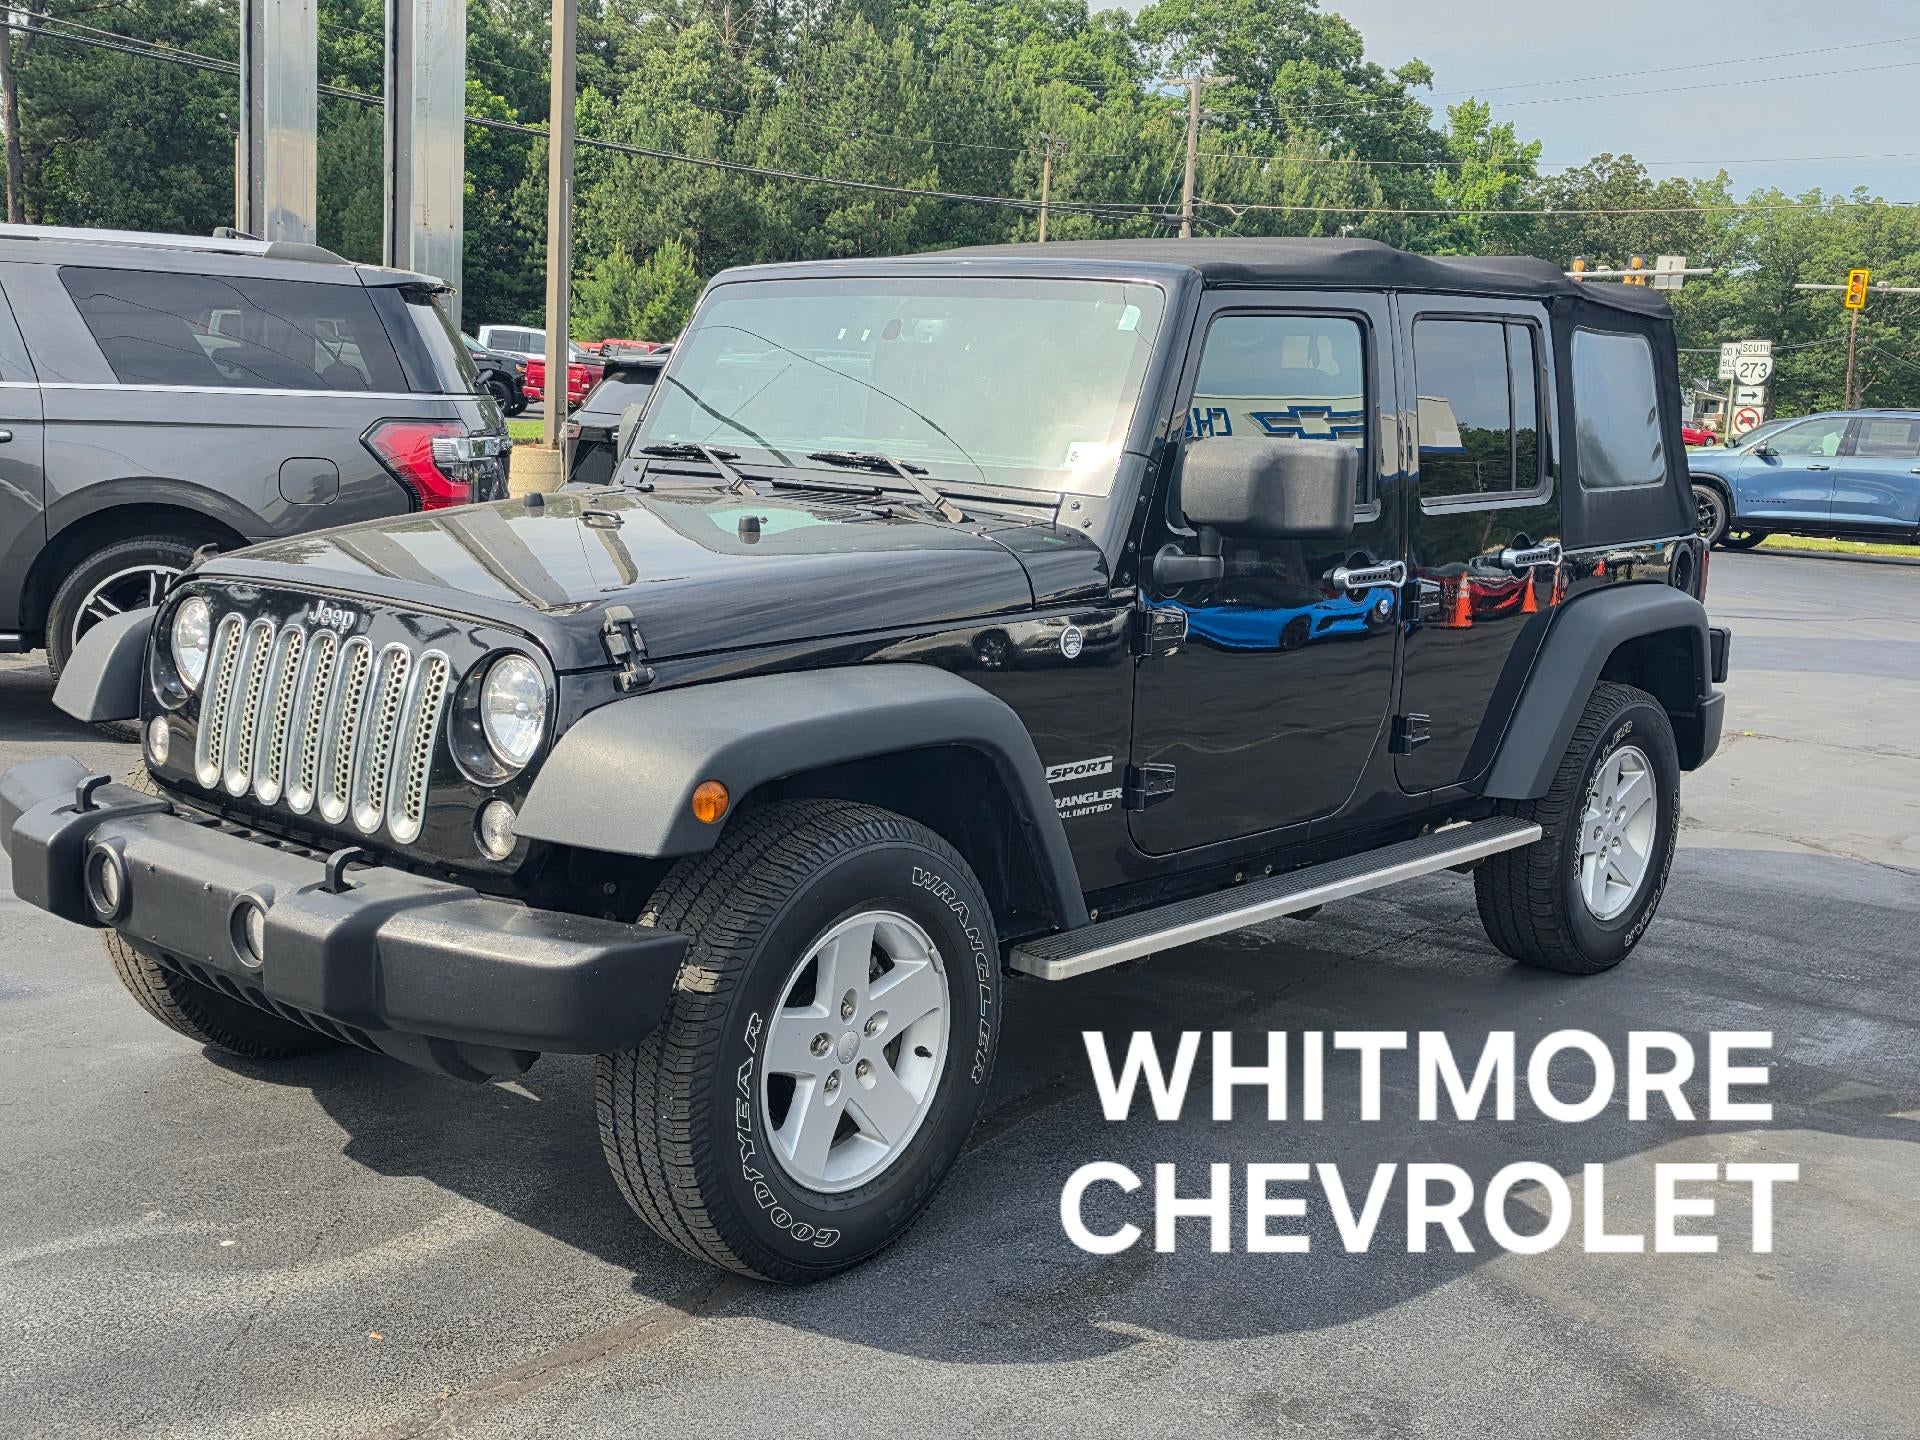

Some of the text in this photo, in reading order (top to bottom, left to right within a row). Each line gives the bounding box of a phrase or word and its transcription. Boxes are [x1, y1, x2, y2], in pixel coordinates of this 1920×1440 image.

[1723, 347, 1733, 357] DO
[1742, 343, 1769, 353] SOUTH
[1739, 362, 1768, 379] 273
[307, 599, 354, 635] Jeep
[1049, 759, 1110, 779] SPORT
[1054, 787, 1123, 809] RANGLER
[1058, 803, 1113, 819] NLIMITED
[911, 866, 992, 1084] WRANGLER
[735, 1012, 841, 1248] GOODYEAR
